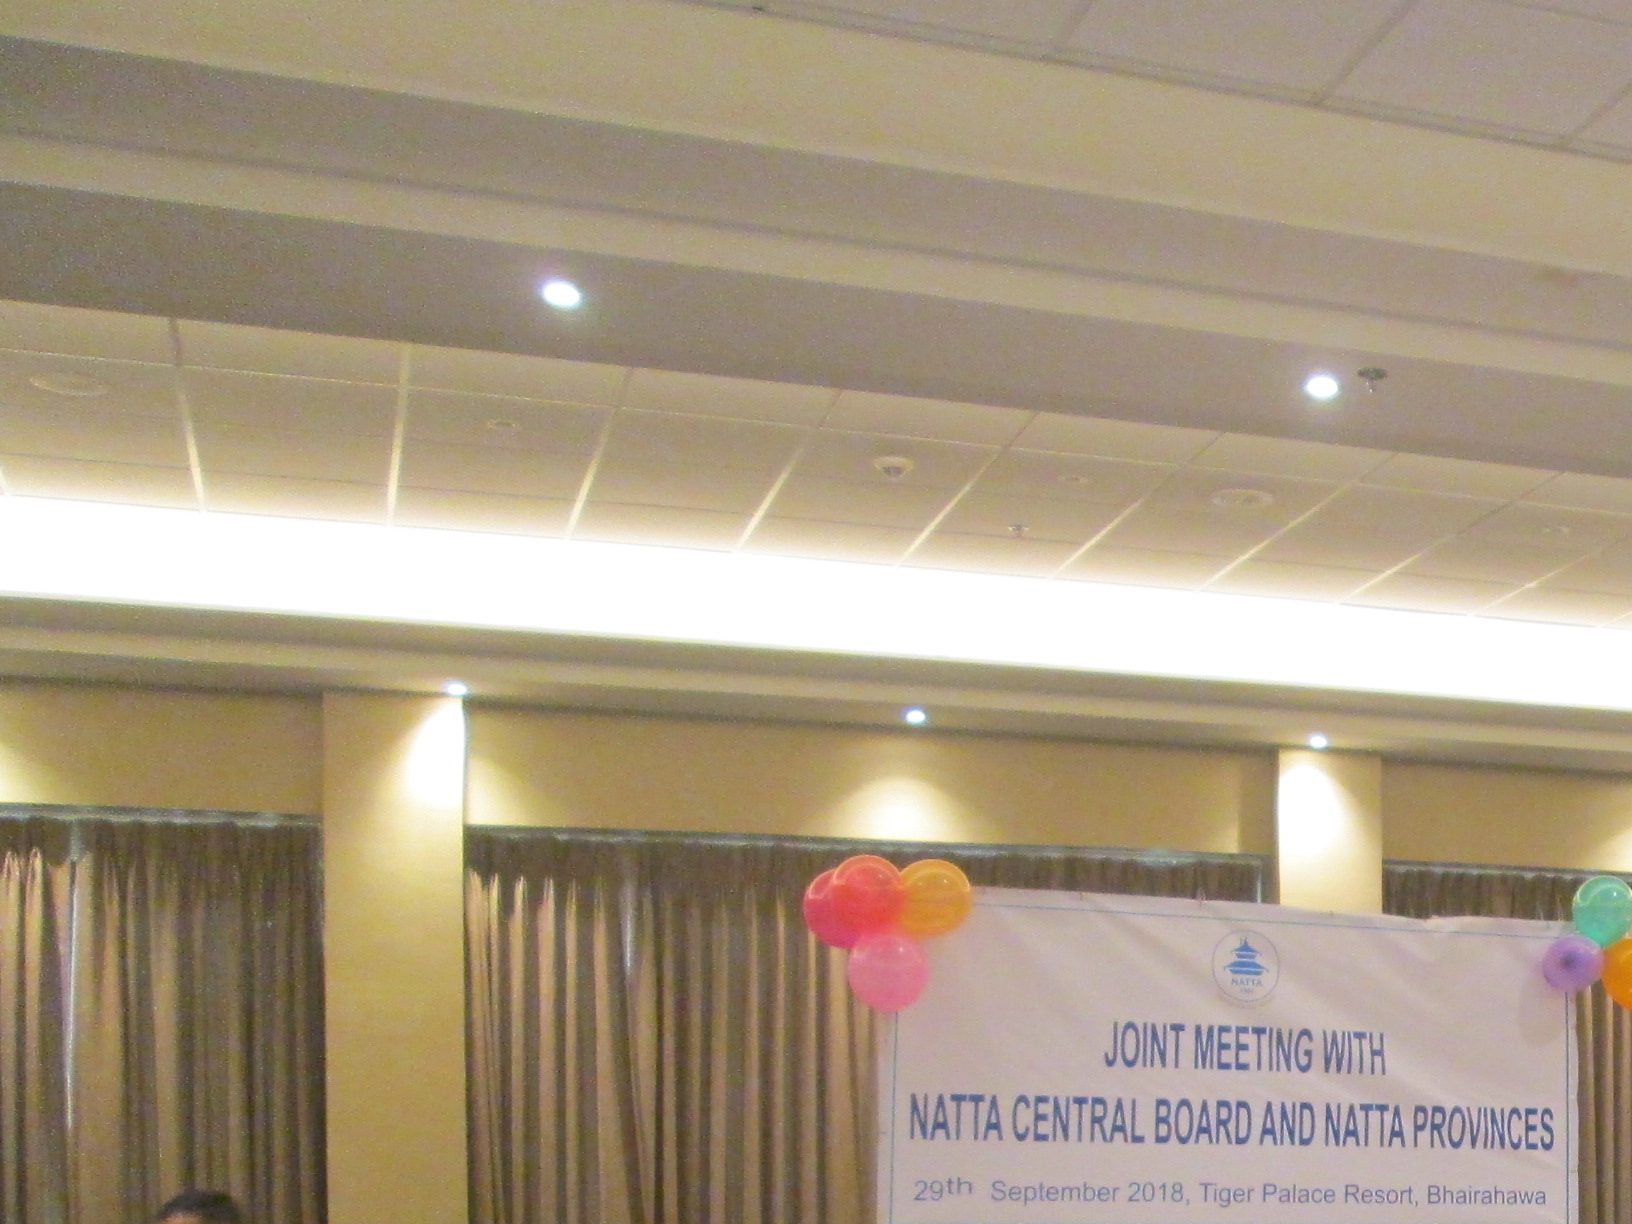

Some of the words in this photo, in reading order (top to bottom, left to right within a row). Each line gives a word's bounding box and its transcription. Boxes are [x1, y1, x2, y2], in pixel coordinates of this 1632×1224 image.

[1103, 1020, 1185, 1070] JOINT
[1193, 1023, 1314, 1074] MEETING
[1322, 1029, 1387, 1076] WITH
[909, 1092, 1004, 1142] NATTA
[1011, 1093, 1146, 1144] CENTRAL
[1153, 1097, 1253, 1146] BOARD
[1258, 1100, 1316, 1147] AND
[1324, 1102, 1407, 1149] NATTA
[1412, 1104, 1556, 1152] PROVINCES
[913, 1176, 974, 1202] 29th
[989, 1180, 1121, 1207] September
[1127, 1181, 1191, 1206] 2018,
[1199, 1182, 1254, 1208] Tiger
[1261, 1183, 1337, 1205] Palace
[1343, 1183, 1419, 1208] Resort,
[1426, 1184, 1548, 1207] Bhairahawa
